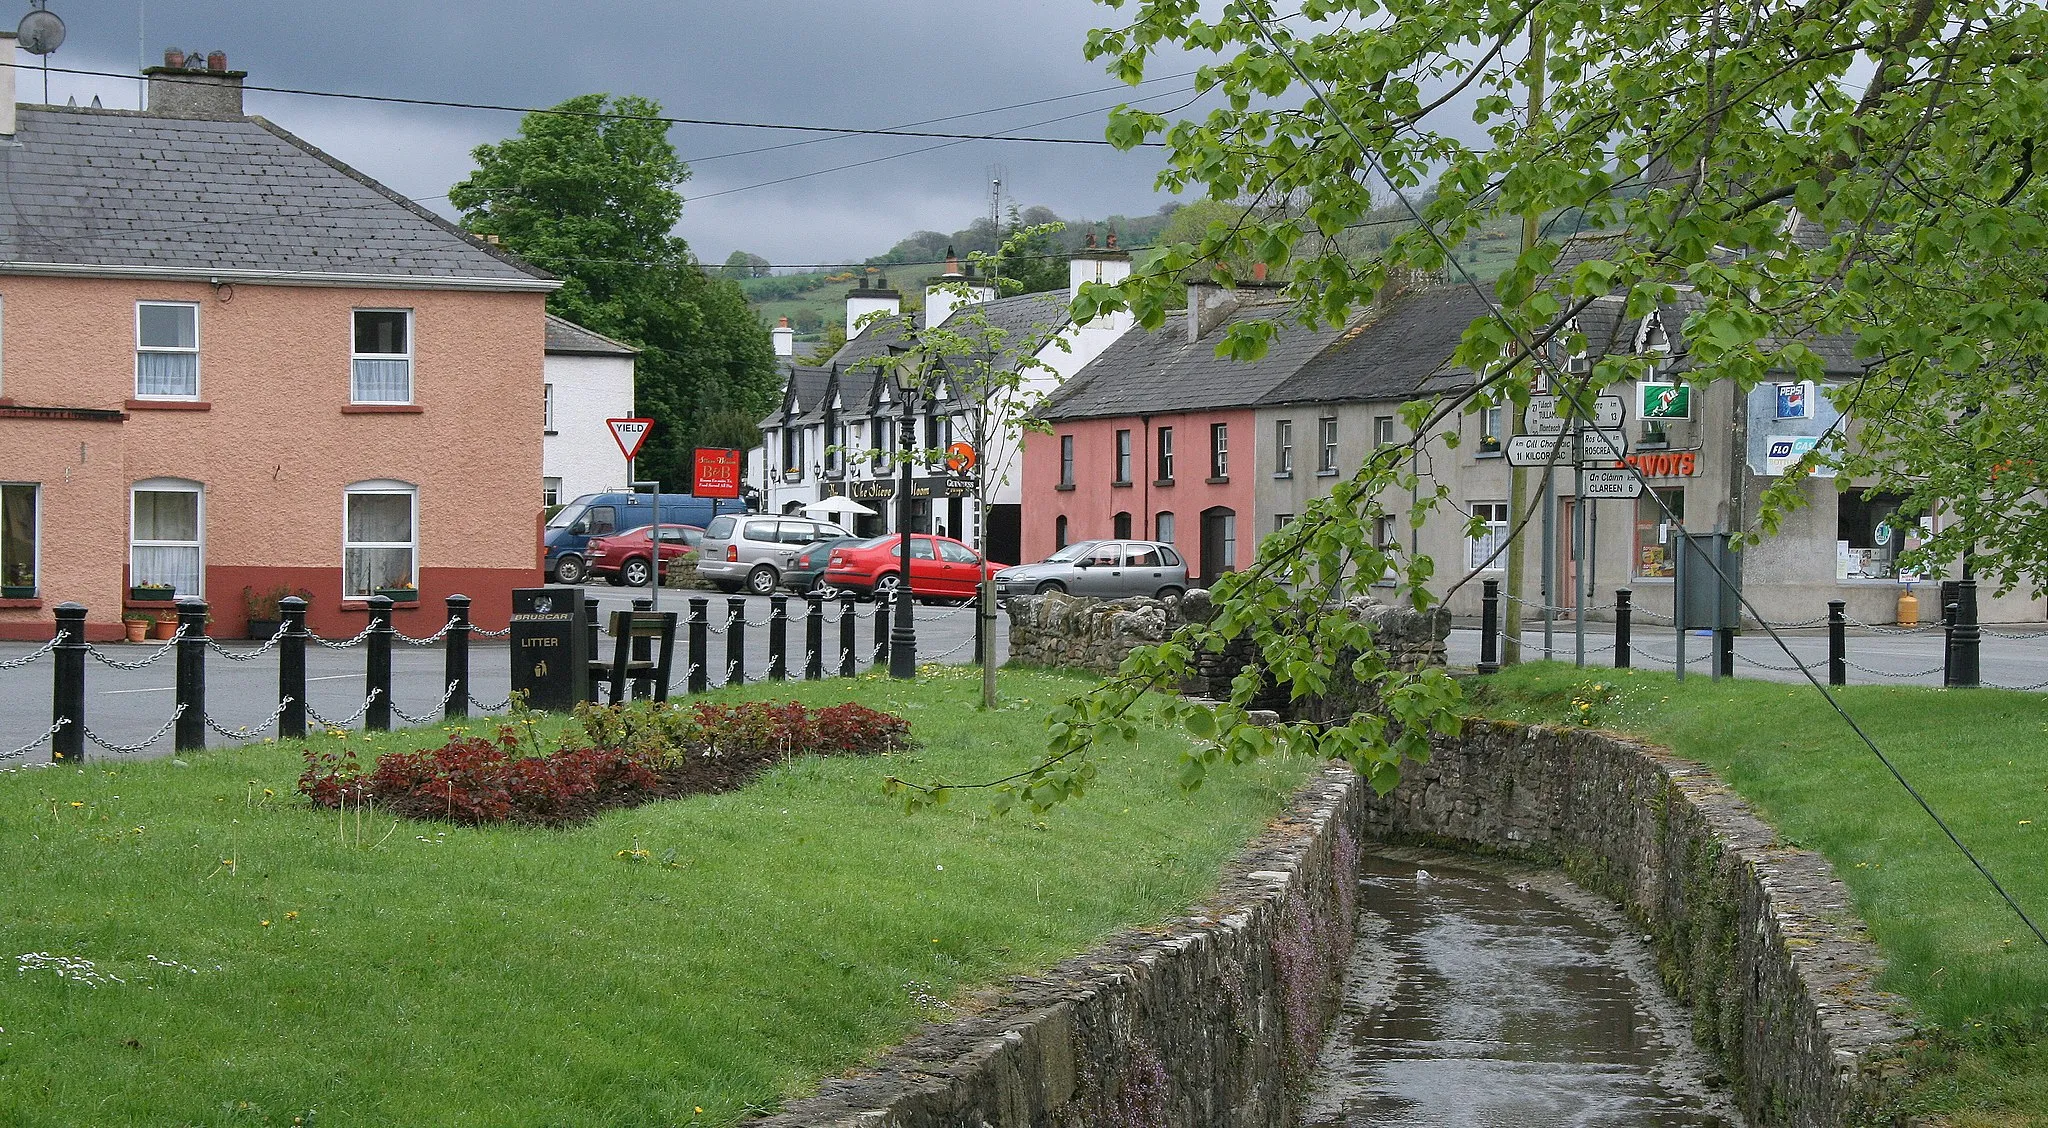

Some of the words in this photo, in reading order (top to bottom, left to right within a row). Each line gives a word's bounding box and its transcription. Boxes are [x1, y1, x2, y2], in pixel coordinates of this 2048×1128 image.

[1780, 385, 1804, 396] PEPSI
[1611, 412, 1617, 421] 13
[616, 424, 644, 432] YIELD
[1585, 434, 1595, 443] Ros
[1526, 440, 1537, 449] Cill
[1540, 439, 1571, 448] Choraic
[1772, 445, 1789, 455] FLO
[1795, 441, 1813, 450] GAS
[1585, 446, 1611, 455] ROSCREA
[1516, 452, 1522, 460] 11
[703, 466, 731, 478] B&B
[852, 481, 867, 497] The
[869, 481, 892, 497] Slieve
[910, 480, 930, 496] loom
[946, 479, 975, 489] GUINNESS
[1589, 484, 1623, 493] CLAREEN
[1628, 484, 1634, 493] 6
[521, 638, 558, 648] LITTER
